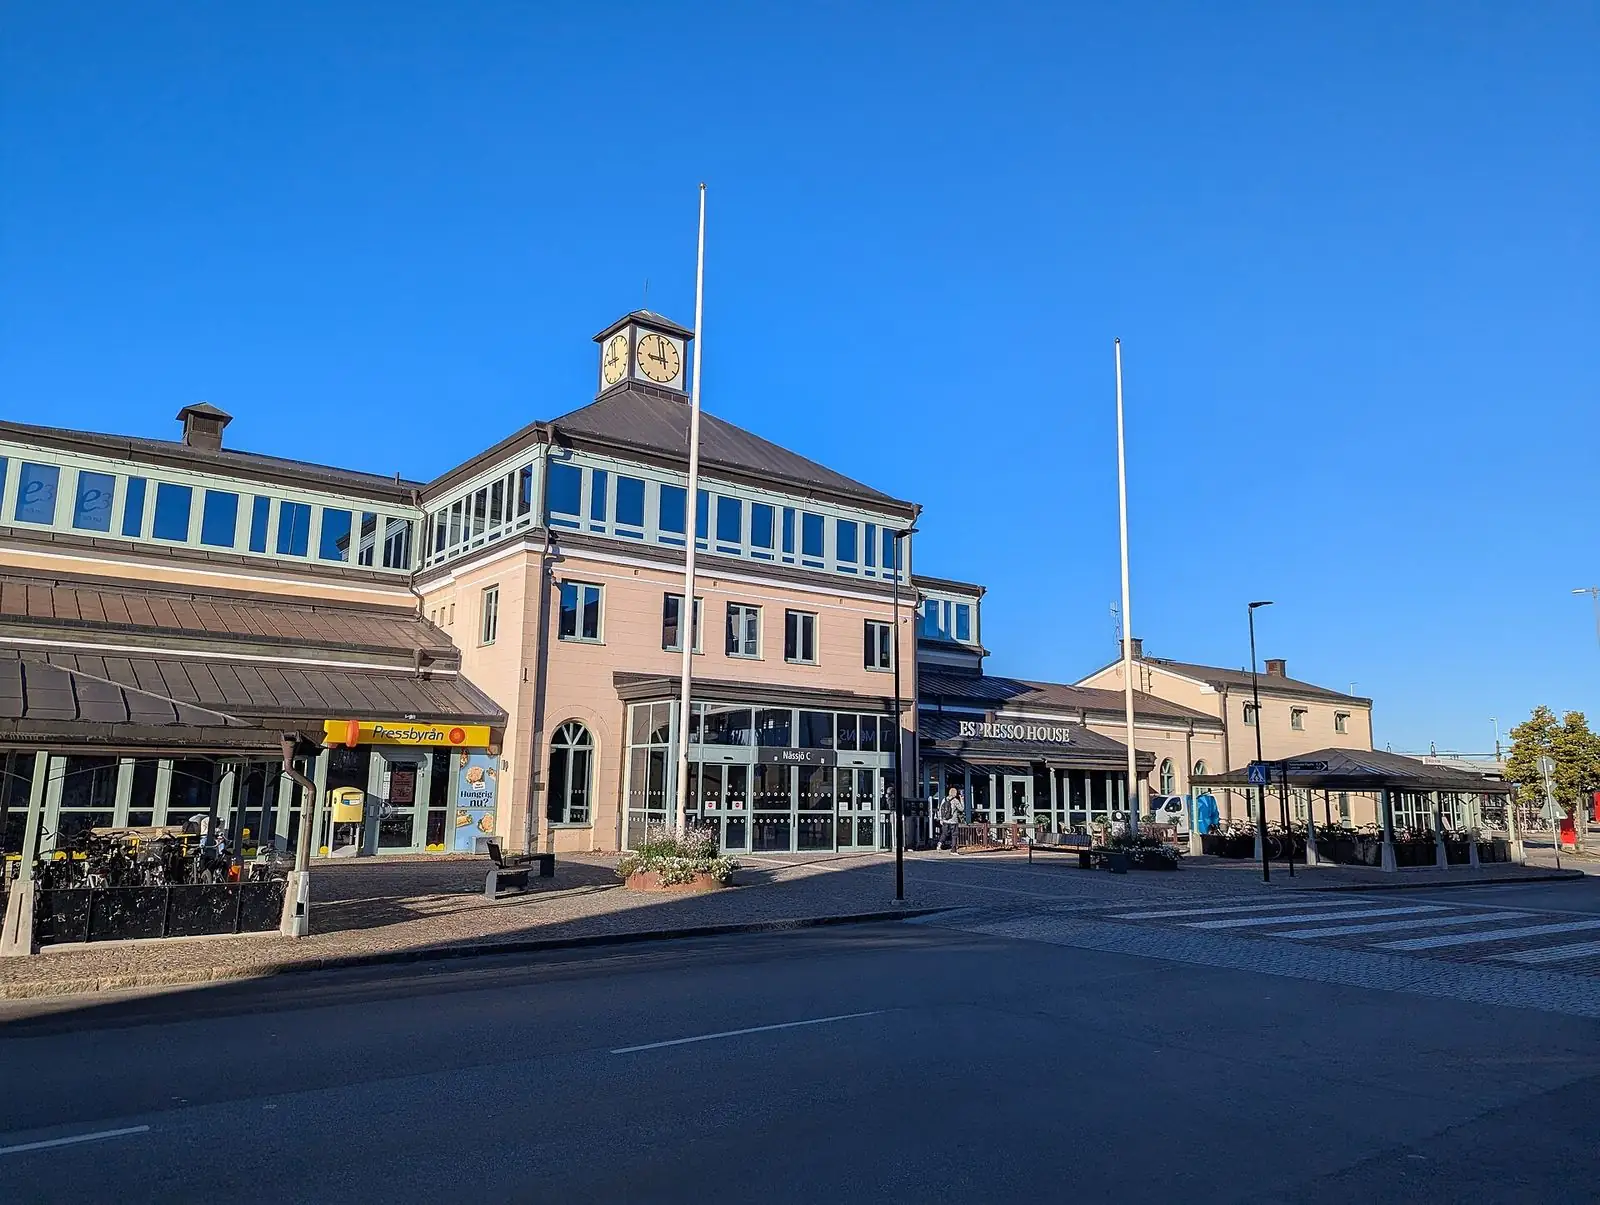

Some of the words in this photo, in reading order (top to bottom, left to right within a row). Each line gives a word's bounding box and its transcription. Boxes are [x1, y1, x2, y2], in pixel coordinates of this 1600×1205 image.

[372, 725, 444, 743] Pressbyrån
[959, 721, 1024, 739] ESPRESSO
[1026, 726, 1070, 742] HOUSE
[782, 750, 805, 762] Nässjö
[806, 752, 811, 760] C
[460, 791, 493, 799] Hungrig
[470, 799, 489, 807] nu?
